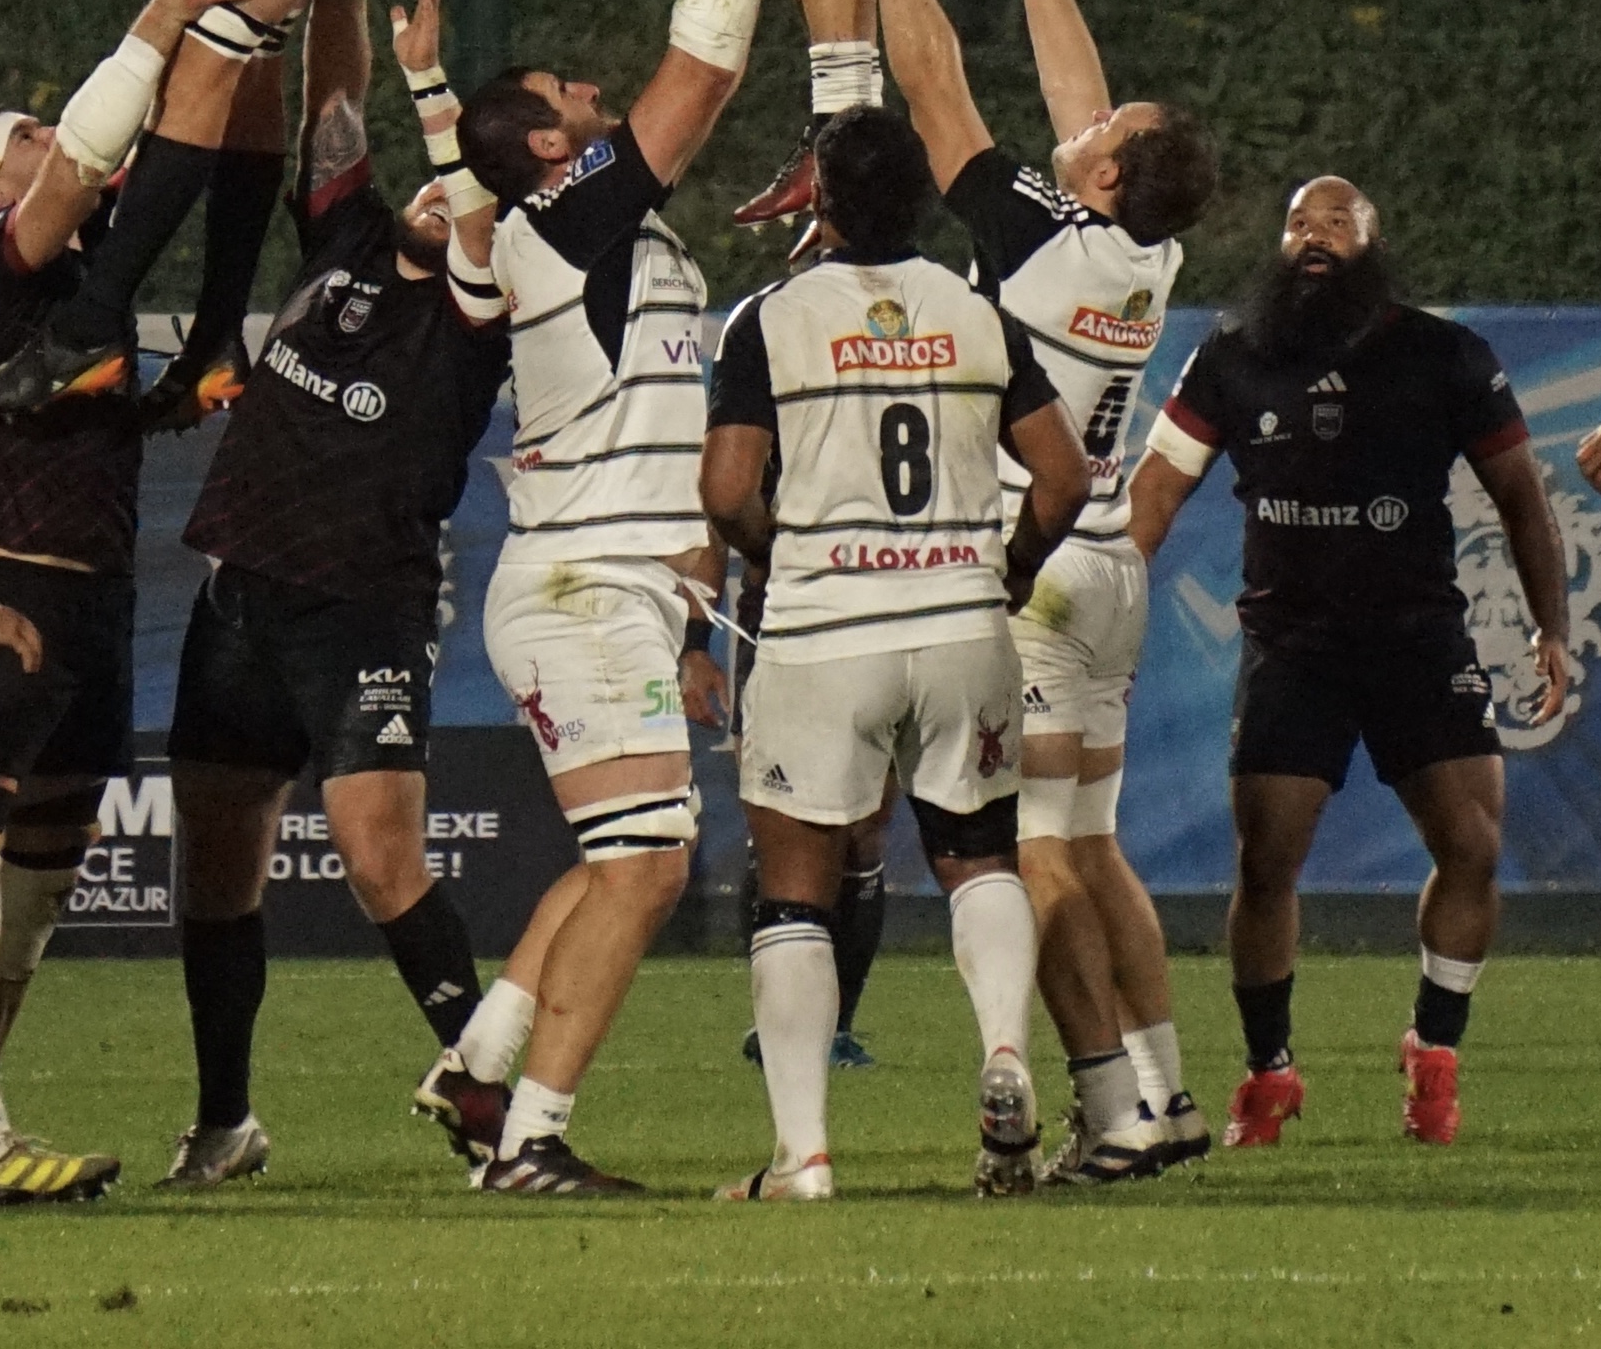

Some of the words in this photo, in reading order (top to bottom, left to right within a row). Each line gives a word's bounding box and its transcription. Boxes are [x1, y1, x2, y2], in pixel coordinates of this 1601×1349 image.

[837, 338, 952, 368] ANDROS
[265, 339, 338, 402] Allianz
[880, 402, 932, 516] 8
[1258, 498, 1360, 526] Allianz
[858, 544, 981, 570] LOXAM
[68, 886, 169, 912] D'AZUR
